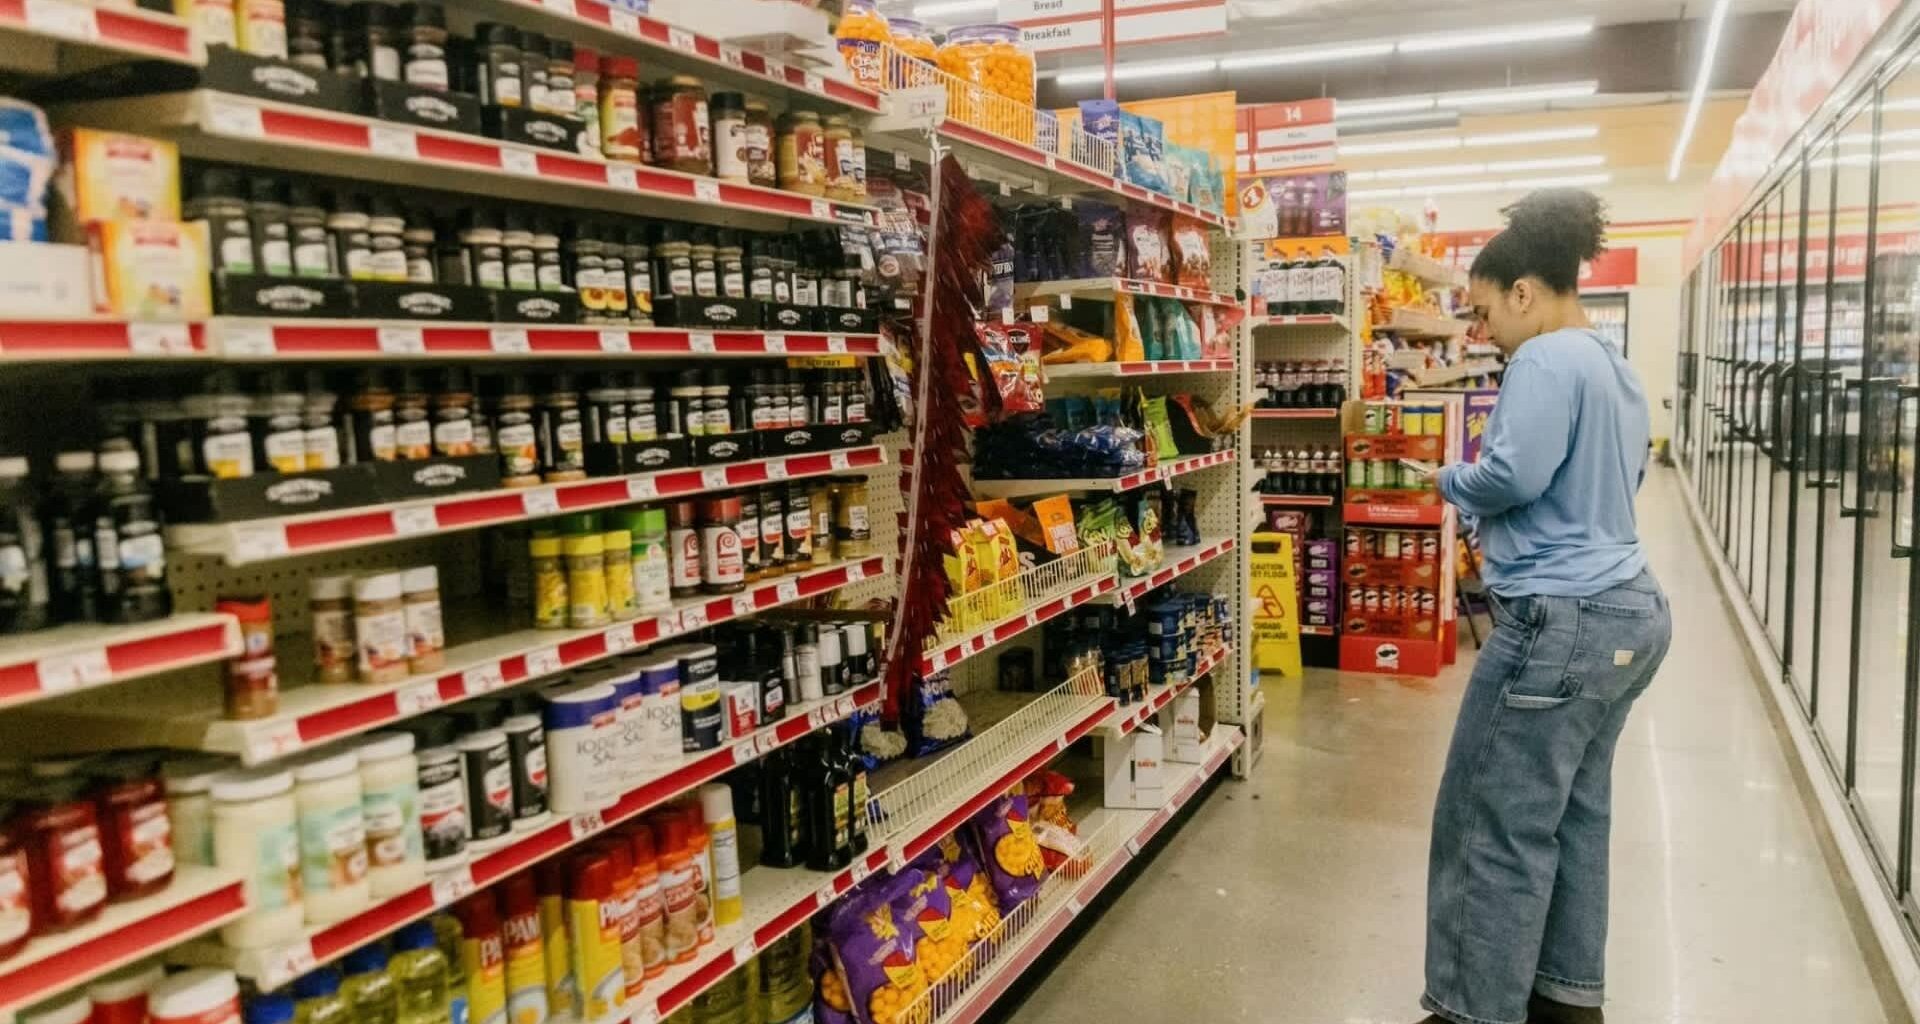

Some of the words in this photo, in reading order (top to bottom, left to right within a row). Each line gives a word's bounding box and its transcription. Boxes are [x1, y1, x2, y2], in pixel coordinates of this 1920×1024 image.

[1033, 0, 1063, 11] Bread
[1023, 28, 1072, 41] Breakfast
[1284, 105, 1302, 121] 14
[502, 911, 541, 946] PAN
